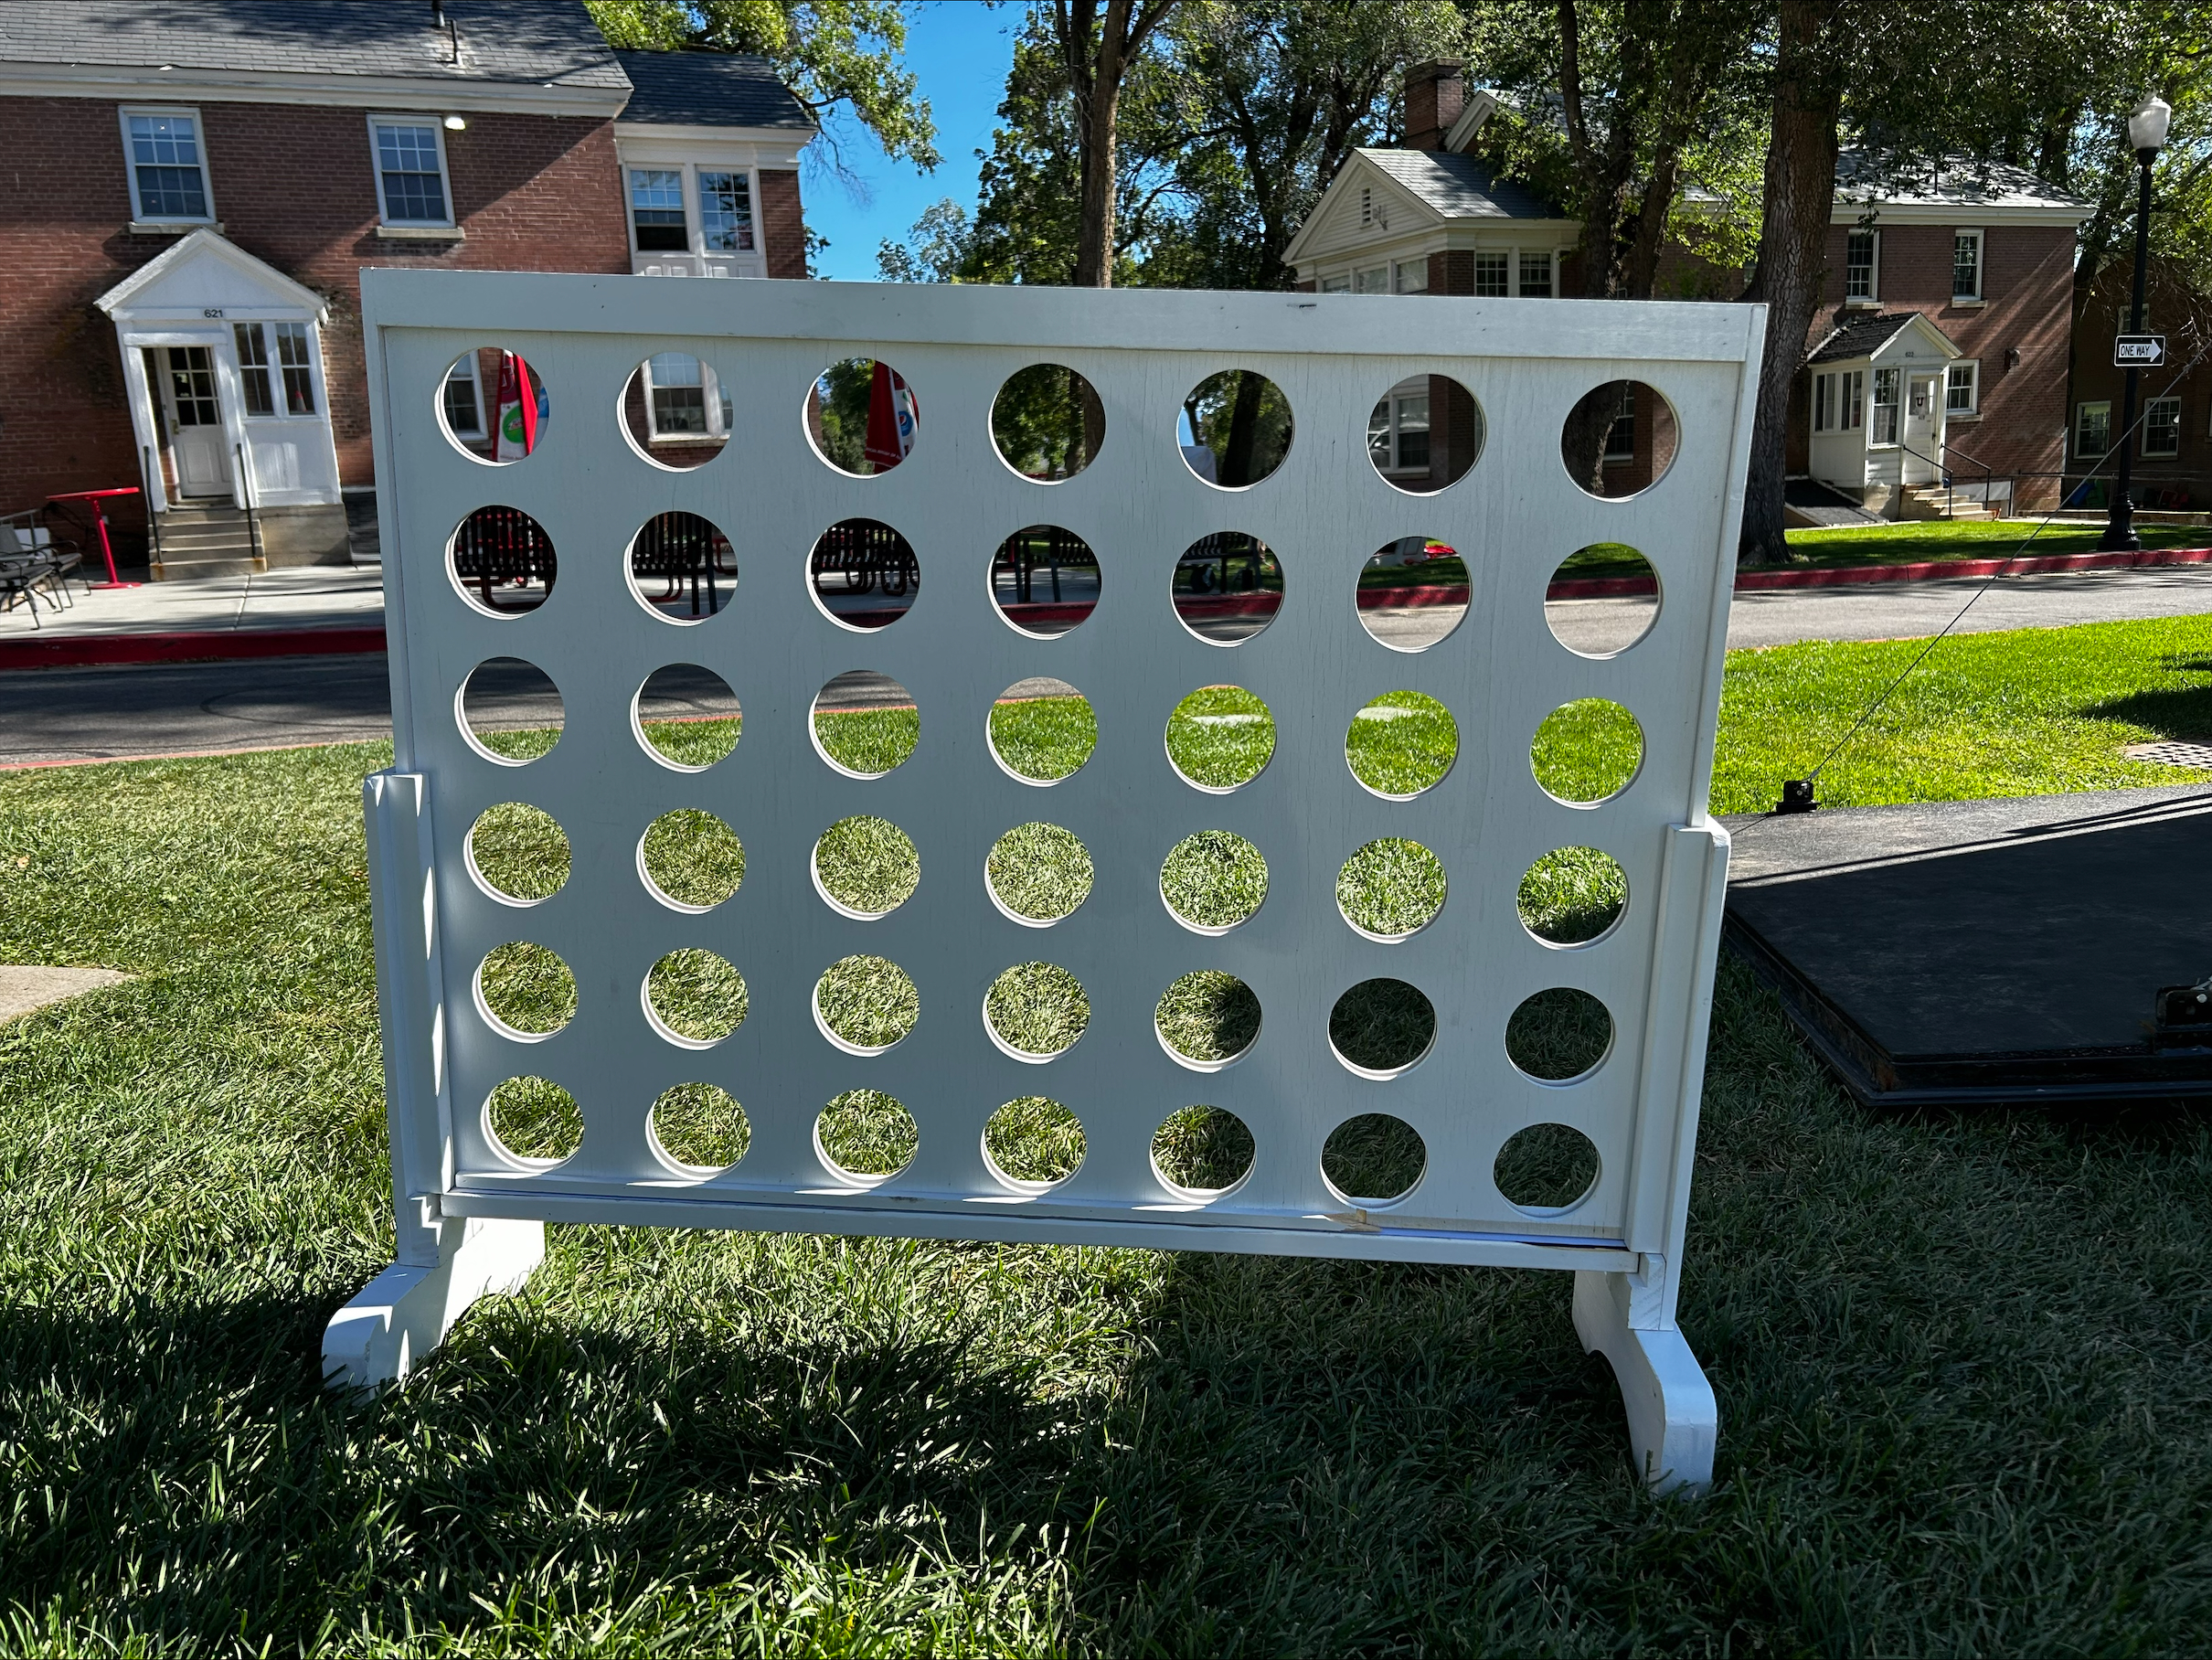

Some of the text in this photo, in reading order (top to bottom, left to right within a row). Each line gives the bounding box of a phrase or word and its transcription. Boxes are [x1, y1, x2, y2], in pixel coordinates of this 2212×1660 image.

[204, 309, 223, 318] 621
[2121, 346, 2150, 356] ONE WAY
